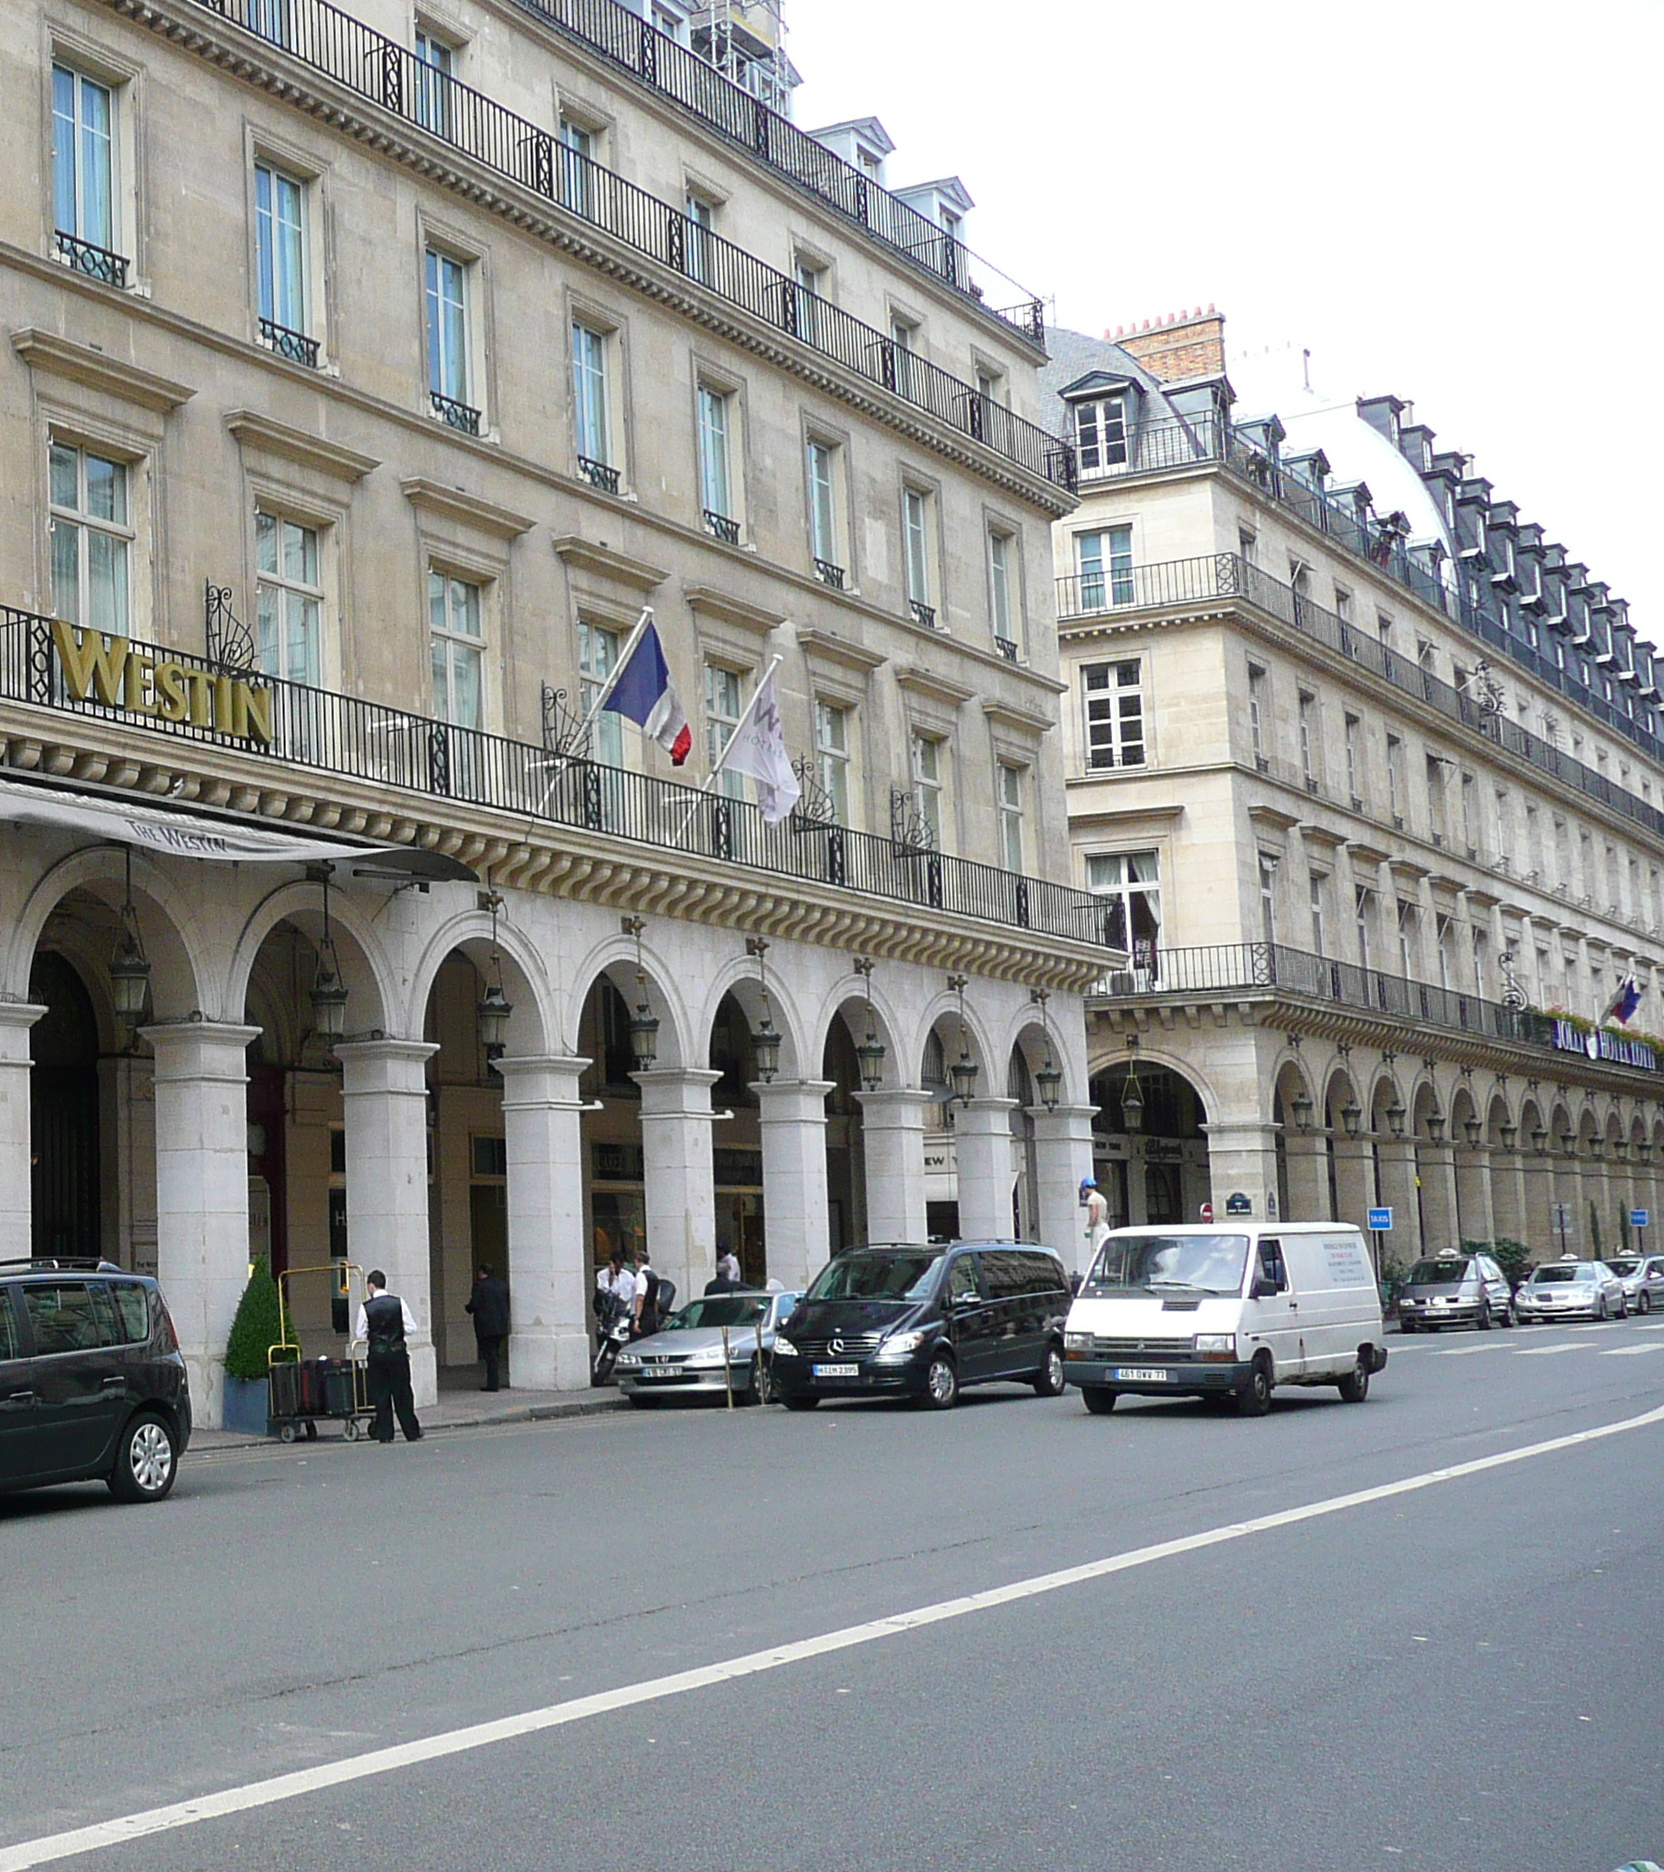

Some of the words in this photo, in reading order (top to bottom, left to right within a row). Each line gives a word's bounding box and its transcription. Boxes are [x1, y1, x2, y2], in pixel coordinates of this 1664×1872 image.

[50, 620, 273, 744] WESTIN
[124, 819, 161, 843] THE
[159, 825, 229, 853] WESTIN
[924, 1156, 945, 1166] EW
